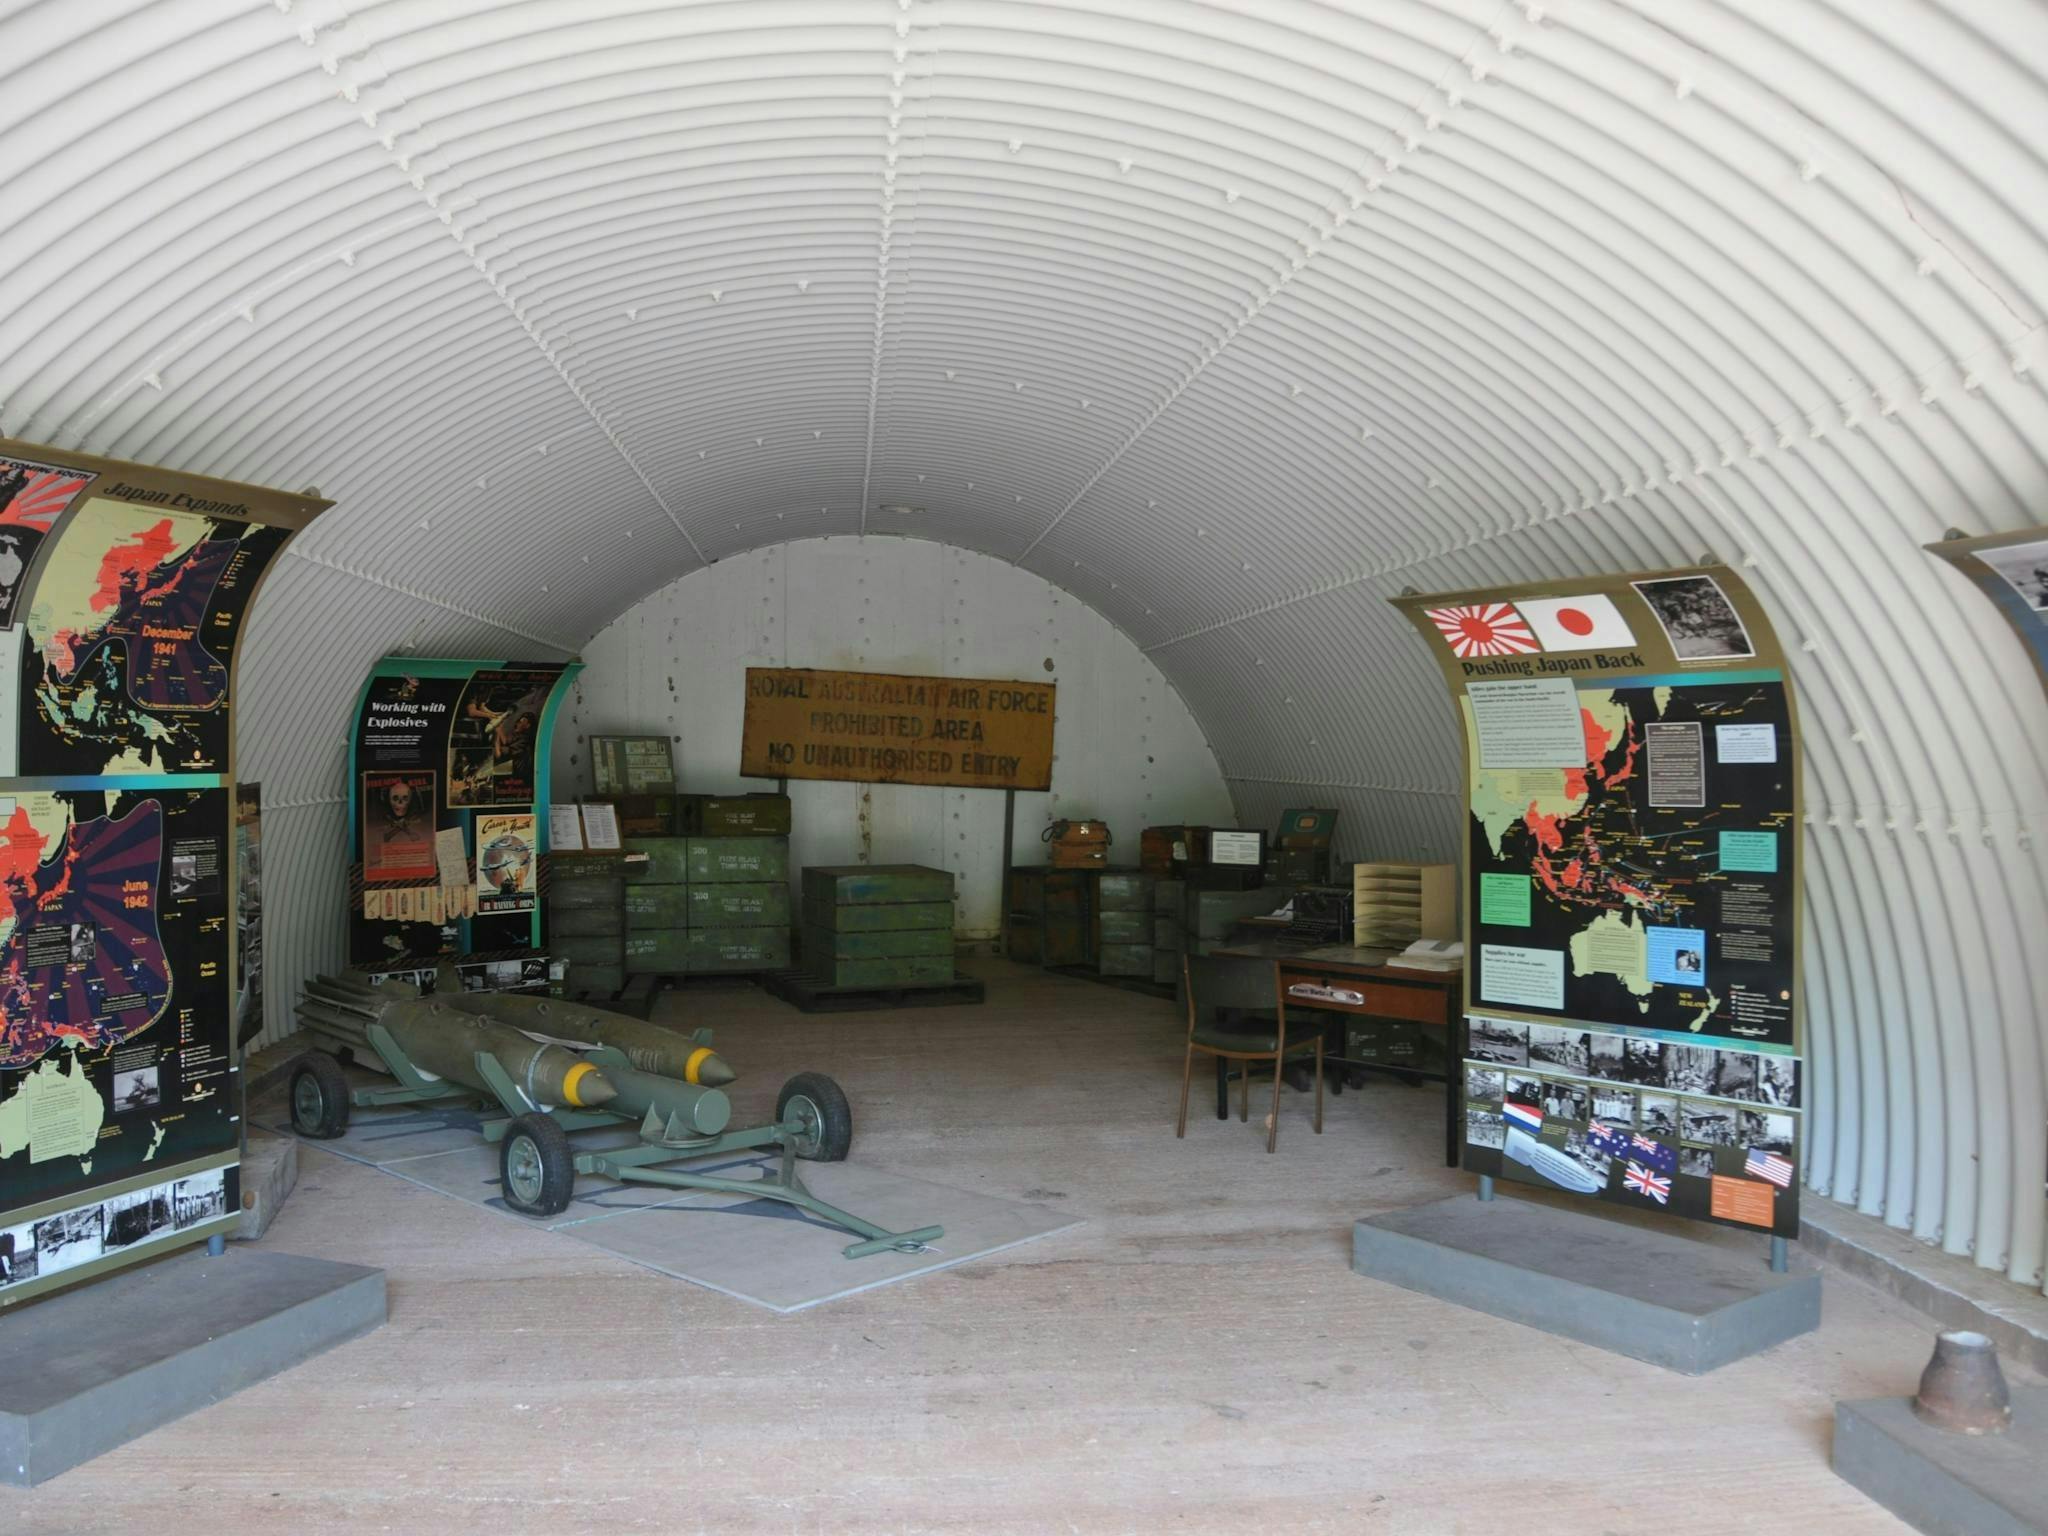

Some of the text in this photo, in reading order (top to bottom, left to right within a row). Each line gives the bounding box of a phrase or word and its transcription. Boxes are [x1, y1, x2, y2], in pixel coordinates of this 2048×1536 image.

[55, 469, 94, 480] SOUTH
[103, 481, 170, 503] Japan
[170, 492, 250, 517] Expands
[142, 624, 195, 641] December
[152, 642, 177, 656] 1941
[1461, 651, 1645, 677] Pushing Japan Back
[750, 675, 809, 700] ROYAL
[946, 686, 980, 710] AIR
[986, 688, 1049, 714] FORCE
[371, 701, 446, 714] Working with
[367, 716, 429, 729] Explosives
[810, 711, 985, 742] PROHIBITED AREA
[768, 742, 1022, 778] NO UNAUTHORISED ENTRY
[122, 879, 149, 893] June
[123, 895, 149, 909] 1942
[1678, 991, 1693, 999] NEW
[1678, 999, 1708, 1009] ZEALAND
